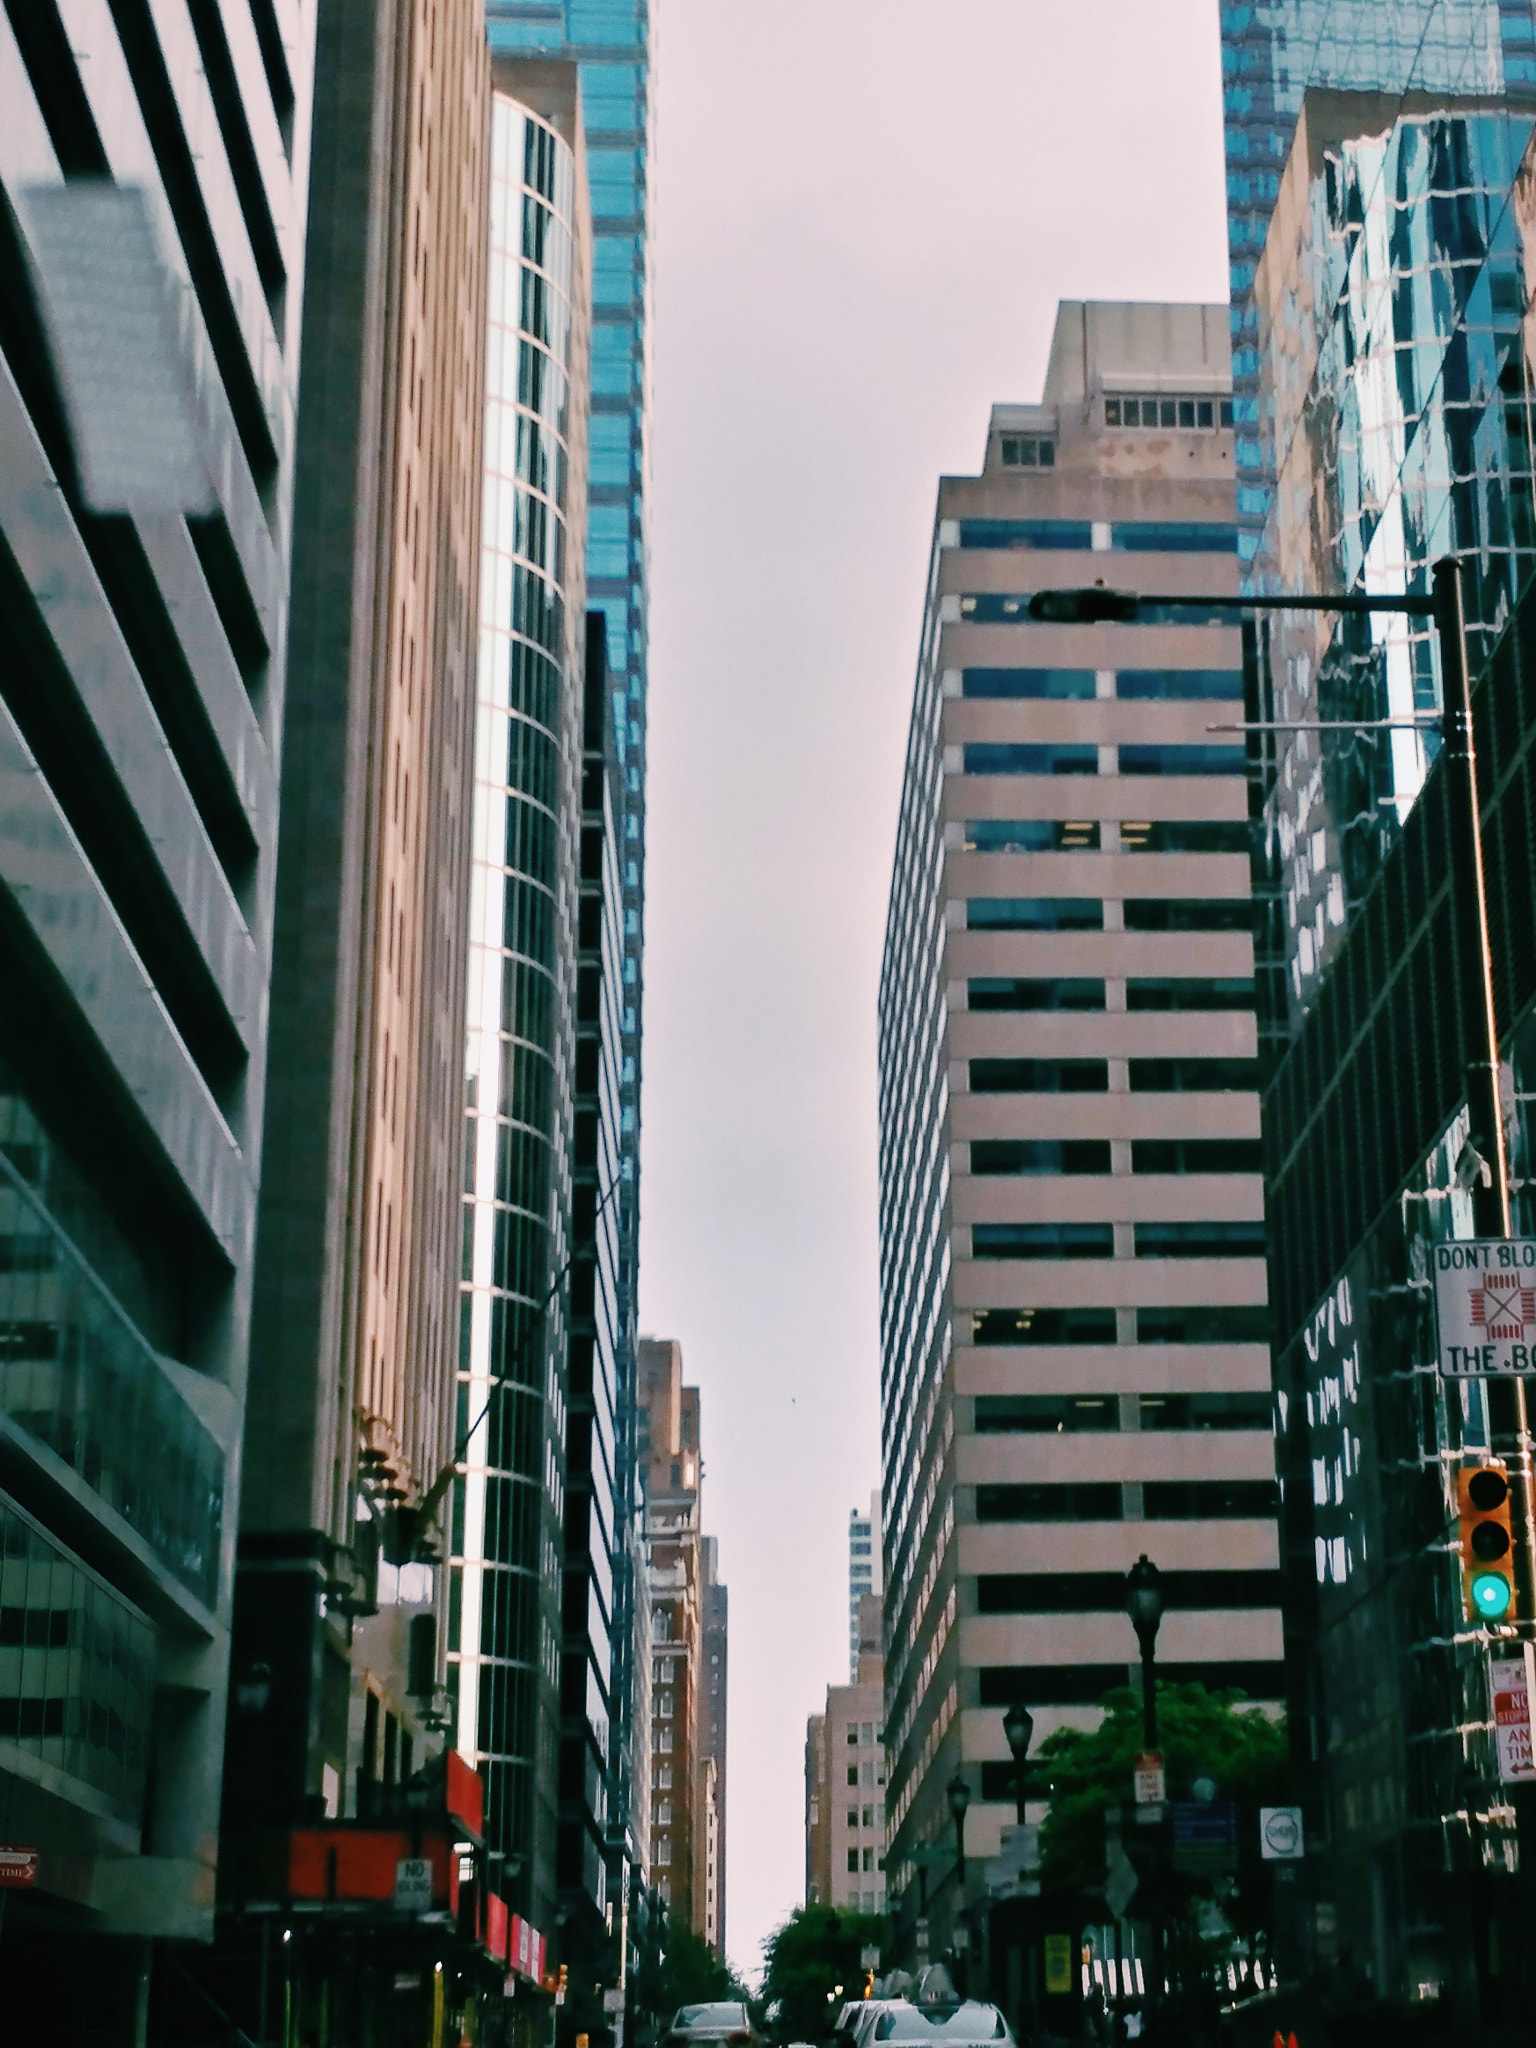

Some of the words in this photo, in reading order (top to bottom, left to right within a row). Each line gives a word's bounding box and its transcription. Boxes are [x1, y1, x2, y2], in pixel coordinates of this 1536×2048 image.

[1439, 1246, 1491, 1270] DONT
[1447, 1345, 1497, 1372] THE
[1508, 1729, 1530, 1743] AN
[1506, 1745, 1532, 1760] TIM
[405, 1862, 425, 1878] NO
